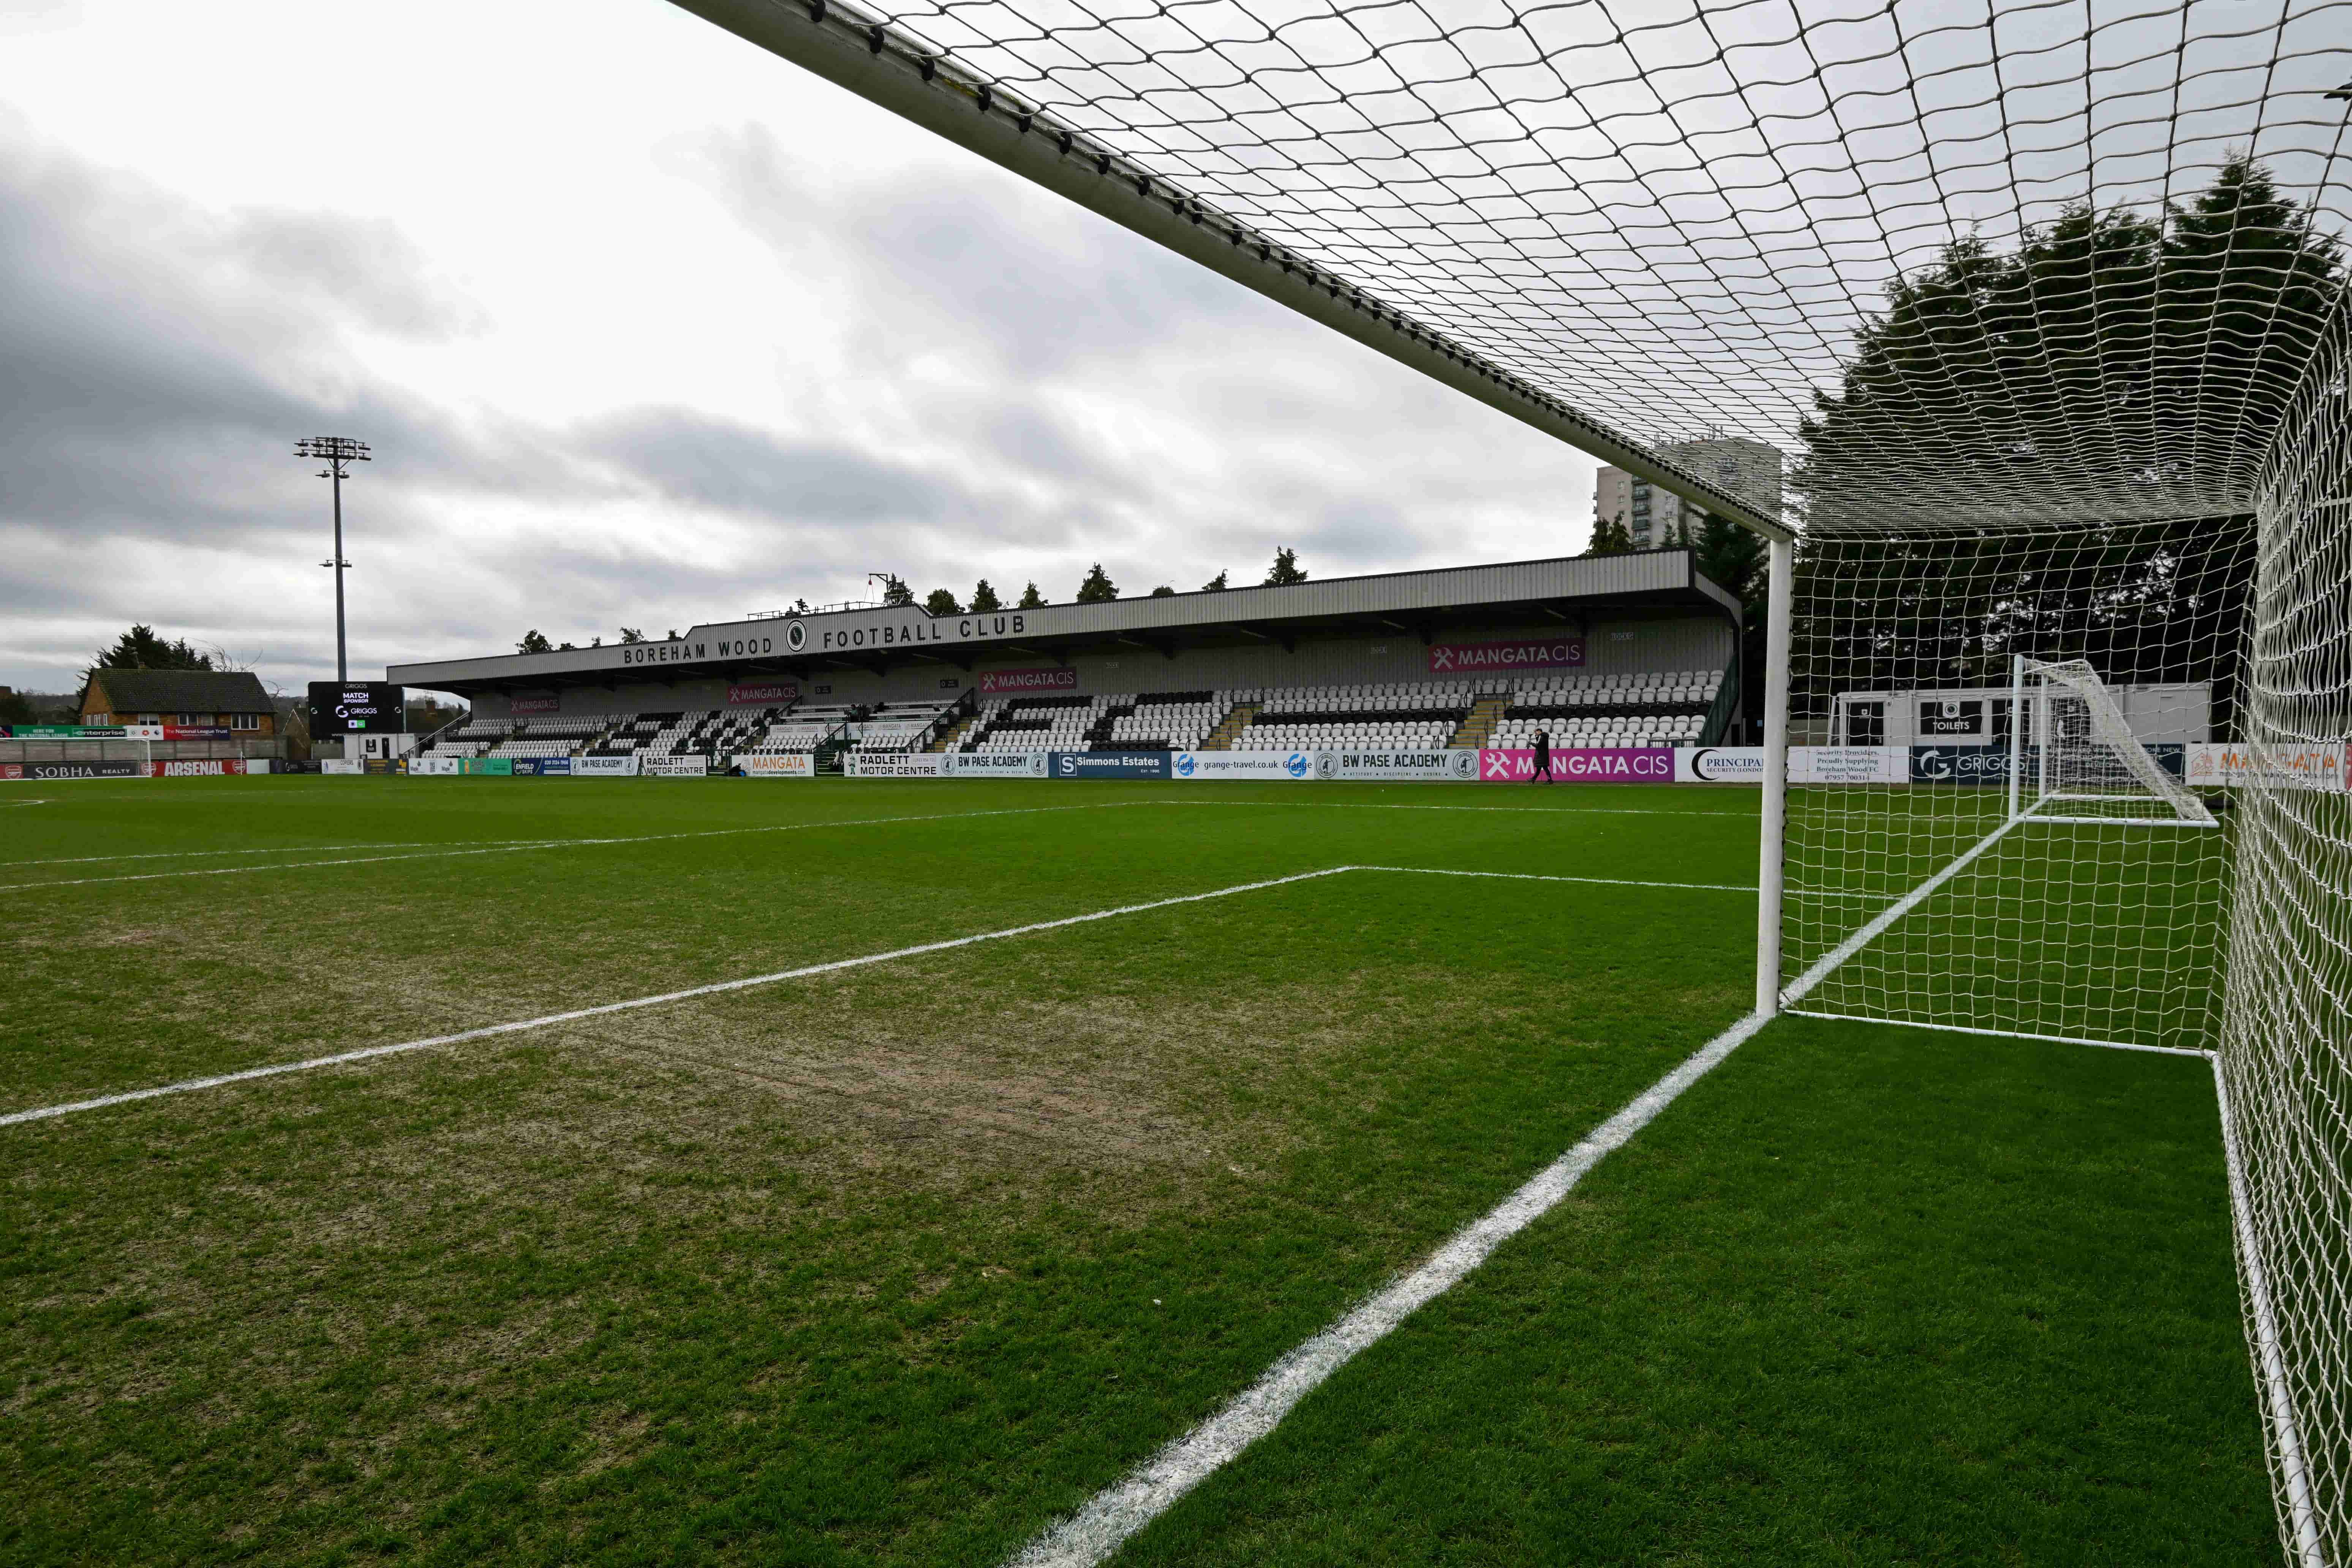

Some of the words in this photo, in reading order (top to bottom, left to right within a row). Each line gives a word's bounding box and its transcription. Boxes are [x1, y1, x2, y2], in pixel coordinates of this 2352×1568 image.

[624, 644, 705, 664] BOREHAM
[718, 639, 771, 657] WOOD
[824, 623, 941, 648] FOOTBALL
[959, 615, 1024, 637] CLUB
[1458, 646, 1549, 665] MANGATA
[1552, 645, 1580, 661] CIS
[998, 673, 1055, 687] MANGATA
[1056, 671, 1073, 684] CIS
[741, 688, 782, 699] MANGATA
[783, 686, 795, 698] CIS
[520, 700, 549, 711] MANGATA
[549, 699, 558, 708] CIS
[1932, 721, 1969, 730] TOILETS
[582, 759, 589, 768] BW
[590, 759, 601, 768] PASE
[602, 759, 623, 768] ACADEMY
[647, 757, 684, 765] RADLETT
[753, 756, 805, 769] MANGATA
[860, 756, 910, 764] RADLETT
[958, 756, 969, 767] BW
[972, 756, 990, 767] PASE
[992, 756, 1027, 767] ACADEMY
[1076, 757, 1119, 765] Simmons
[1122, 757, 1159, 765] Estates
[1173, 761, 1200, 770] Grange
[1204, 760, 1278, 770] grange-travel.co.uk
[1282, 761, 1312, 770] Grange
[1342, 754, 1360, 767] BW
[1364, 754, 1389, 768] PASE
[1394, 754, 1448, 767] ACADEMY
[1516, 756, 1630, 774] MNGATA
[1633, 756, 1668, 775] CIS
[35, 767, 94, 778] SOBHA
[164, 761, 225, 776] ARSENAL
[860, 767, 894, 775] MOTOR
